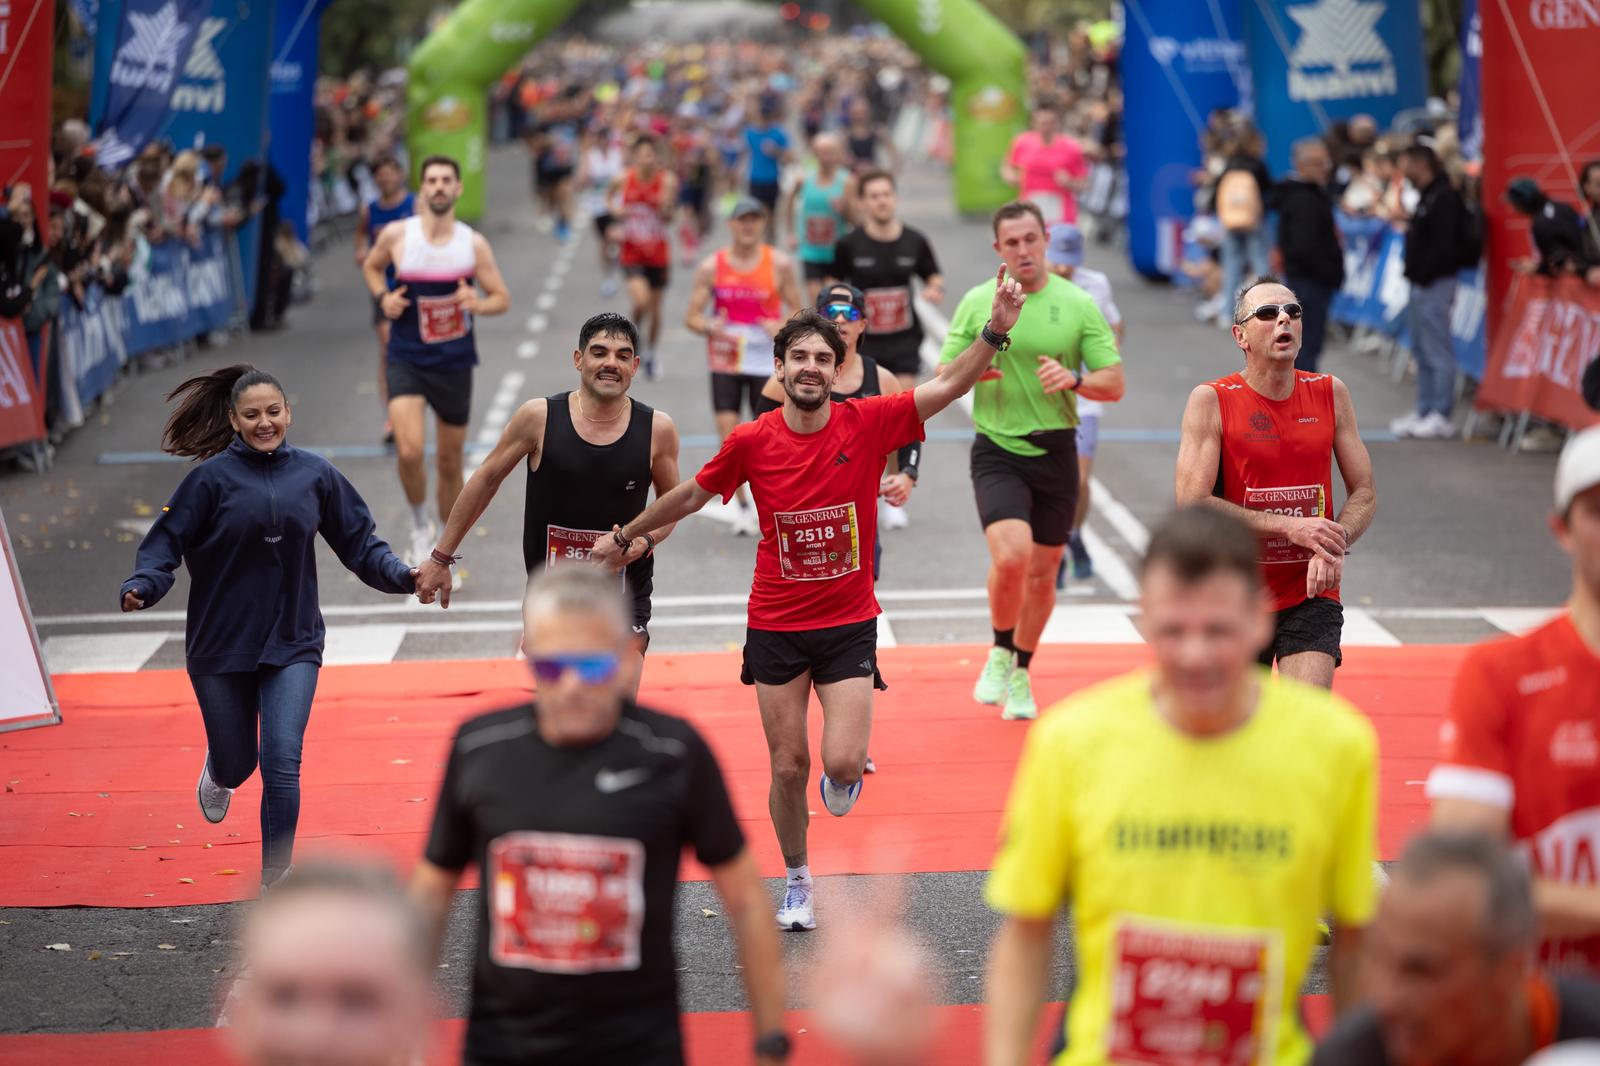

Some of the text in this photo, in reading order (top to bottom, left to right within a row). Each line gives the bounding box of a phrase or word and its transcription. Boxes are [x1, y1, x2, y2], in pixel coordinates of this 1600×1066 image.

[1265, 489, 1315, 503] GENERALI
[795, 508, 844, 524] GENERALI
[795, 526, 835, 543] 2518
[565, 545, 594, 560] 367
